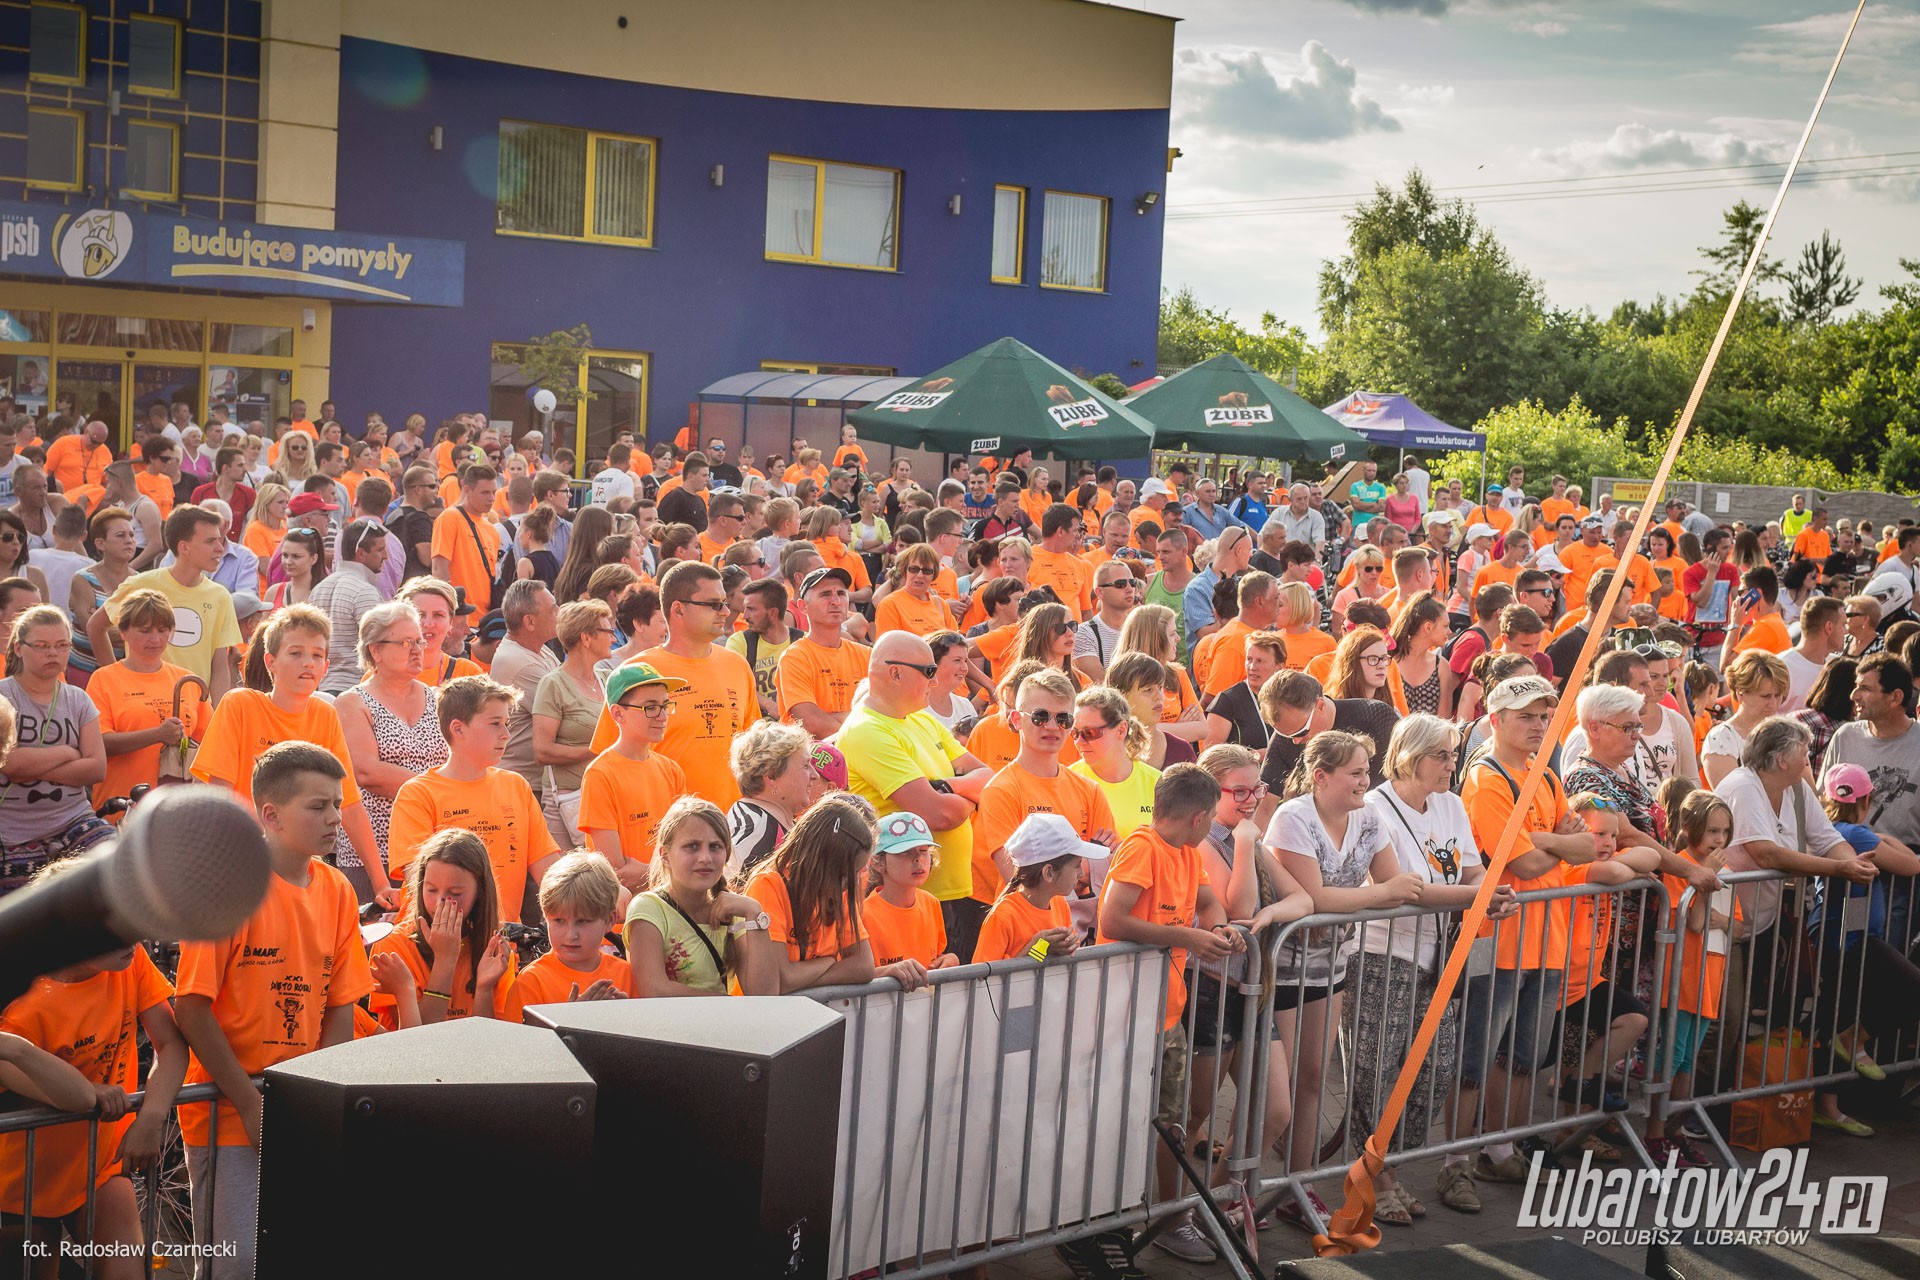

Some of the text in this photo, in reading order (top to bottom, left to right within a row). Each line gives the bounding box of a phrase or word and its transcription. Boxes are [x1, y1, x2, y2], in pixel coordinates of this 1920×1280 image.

[2, 216, 39, 261] psb
[173, 225, 296, 267] Budujące
[887, 394, 941, 406] ŻUBR
[1053, 403, 1104, 423] ŻUBR
[1209, 409, 1269, 421] ŻUBR
[973, 440, 998, 450] ŻUBR
[1415, 435, 1476, 448] www.lubartow.pl
